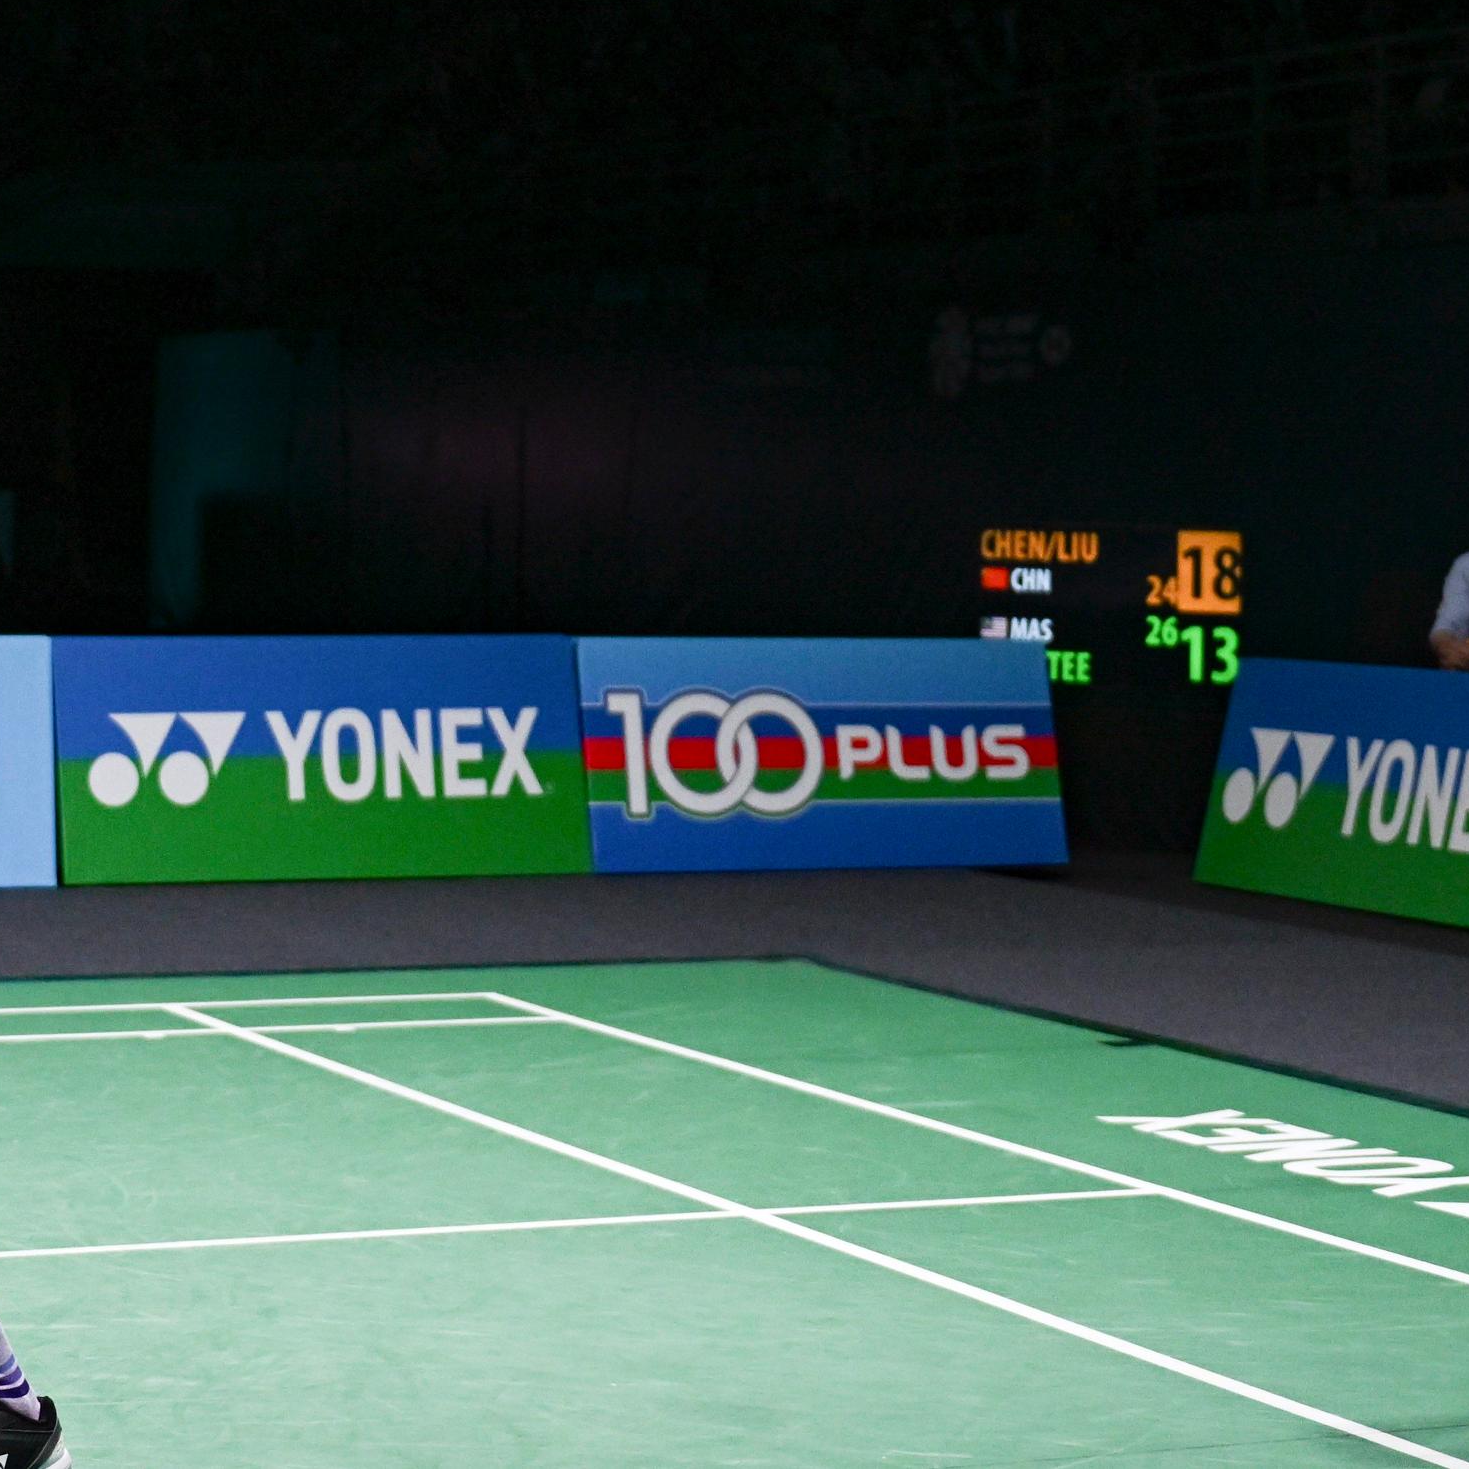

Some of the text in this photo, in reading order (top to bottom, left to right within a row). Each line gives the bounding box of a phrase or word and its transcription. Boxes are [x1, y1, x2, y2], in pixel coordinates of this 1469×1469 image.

[981, 530, 1098, 562] CHEN/LIU
[1011, 568, 1052, 592] CHN
[1184, 546, 1241, 600] 18
[1010, 617, 1053, 642] MAS
[1145, 615, 1178, 646] 26
[1180, 626, 1239, 683] 13
[264, 706, 544, 802] YONEX
